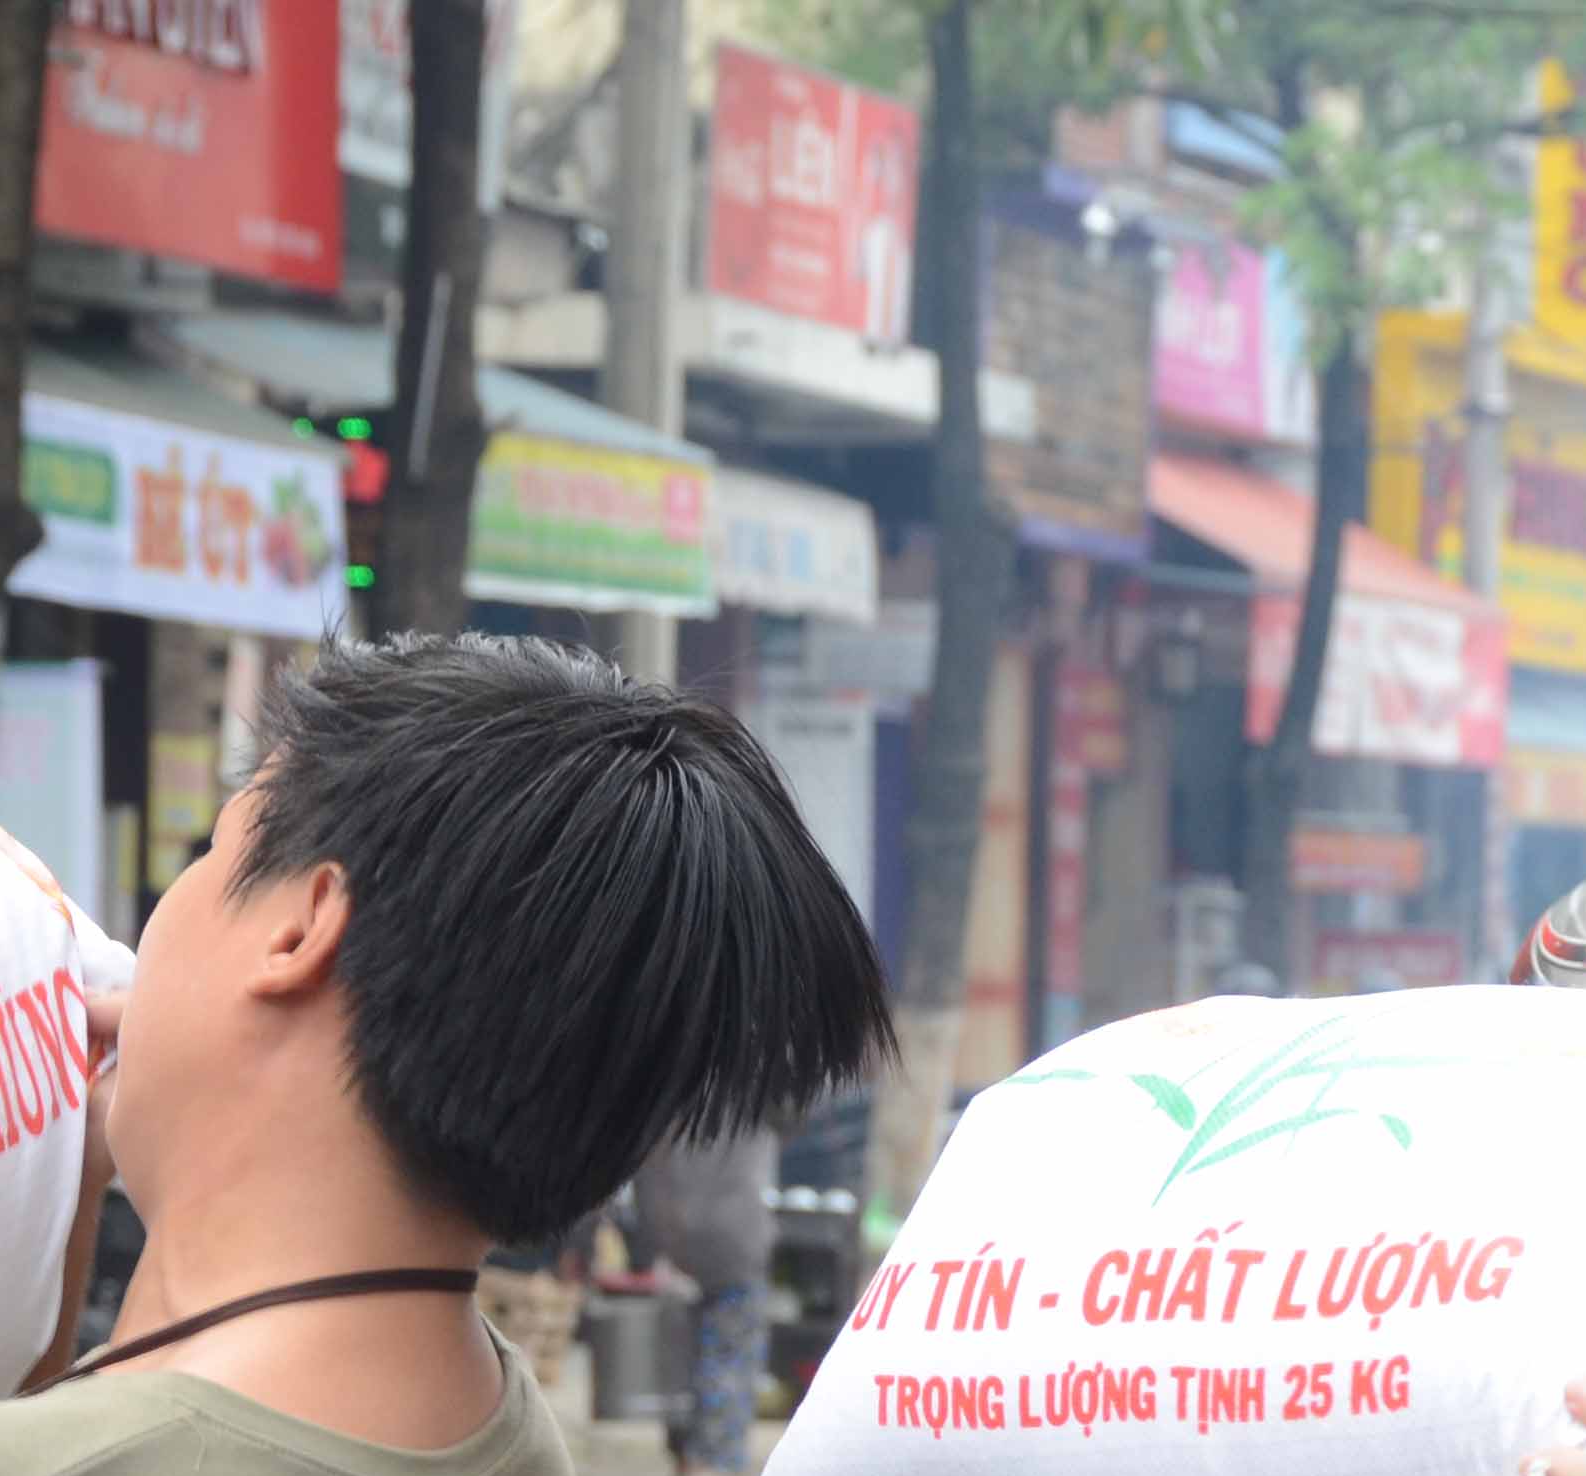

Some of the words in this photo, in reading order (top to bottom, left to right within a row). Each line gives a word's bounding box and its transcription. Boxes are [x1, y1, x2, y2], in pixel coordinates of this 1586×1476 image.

[925, 1242, 1025, 1331] TÍN
[1040, 1293, 1058, 1308] -
[1082, 1220, 1266, 1326] CHẤT
[1273, 1232, 1524, 1331] LƯỢNG
[874, 1375, 1005, 1439] TRỌNG
[1019, 1362, 1157, 1438] LƯỢNG
[1171, 1366, 1265, 1435] TỊNH
[1283, 1363, 1333, 1420] 25
[1350, 1355, 1410, 1414] KG
